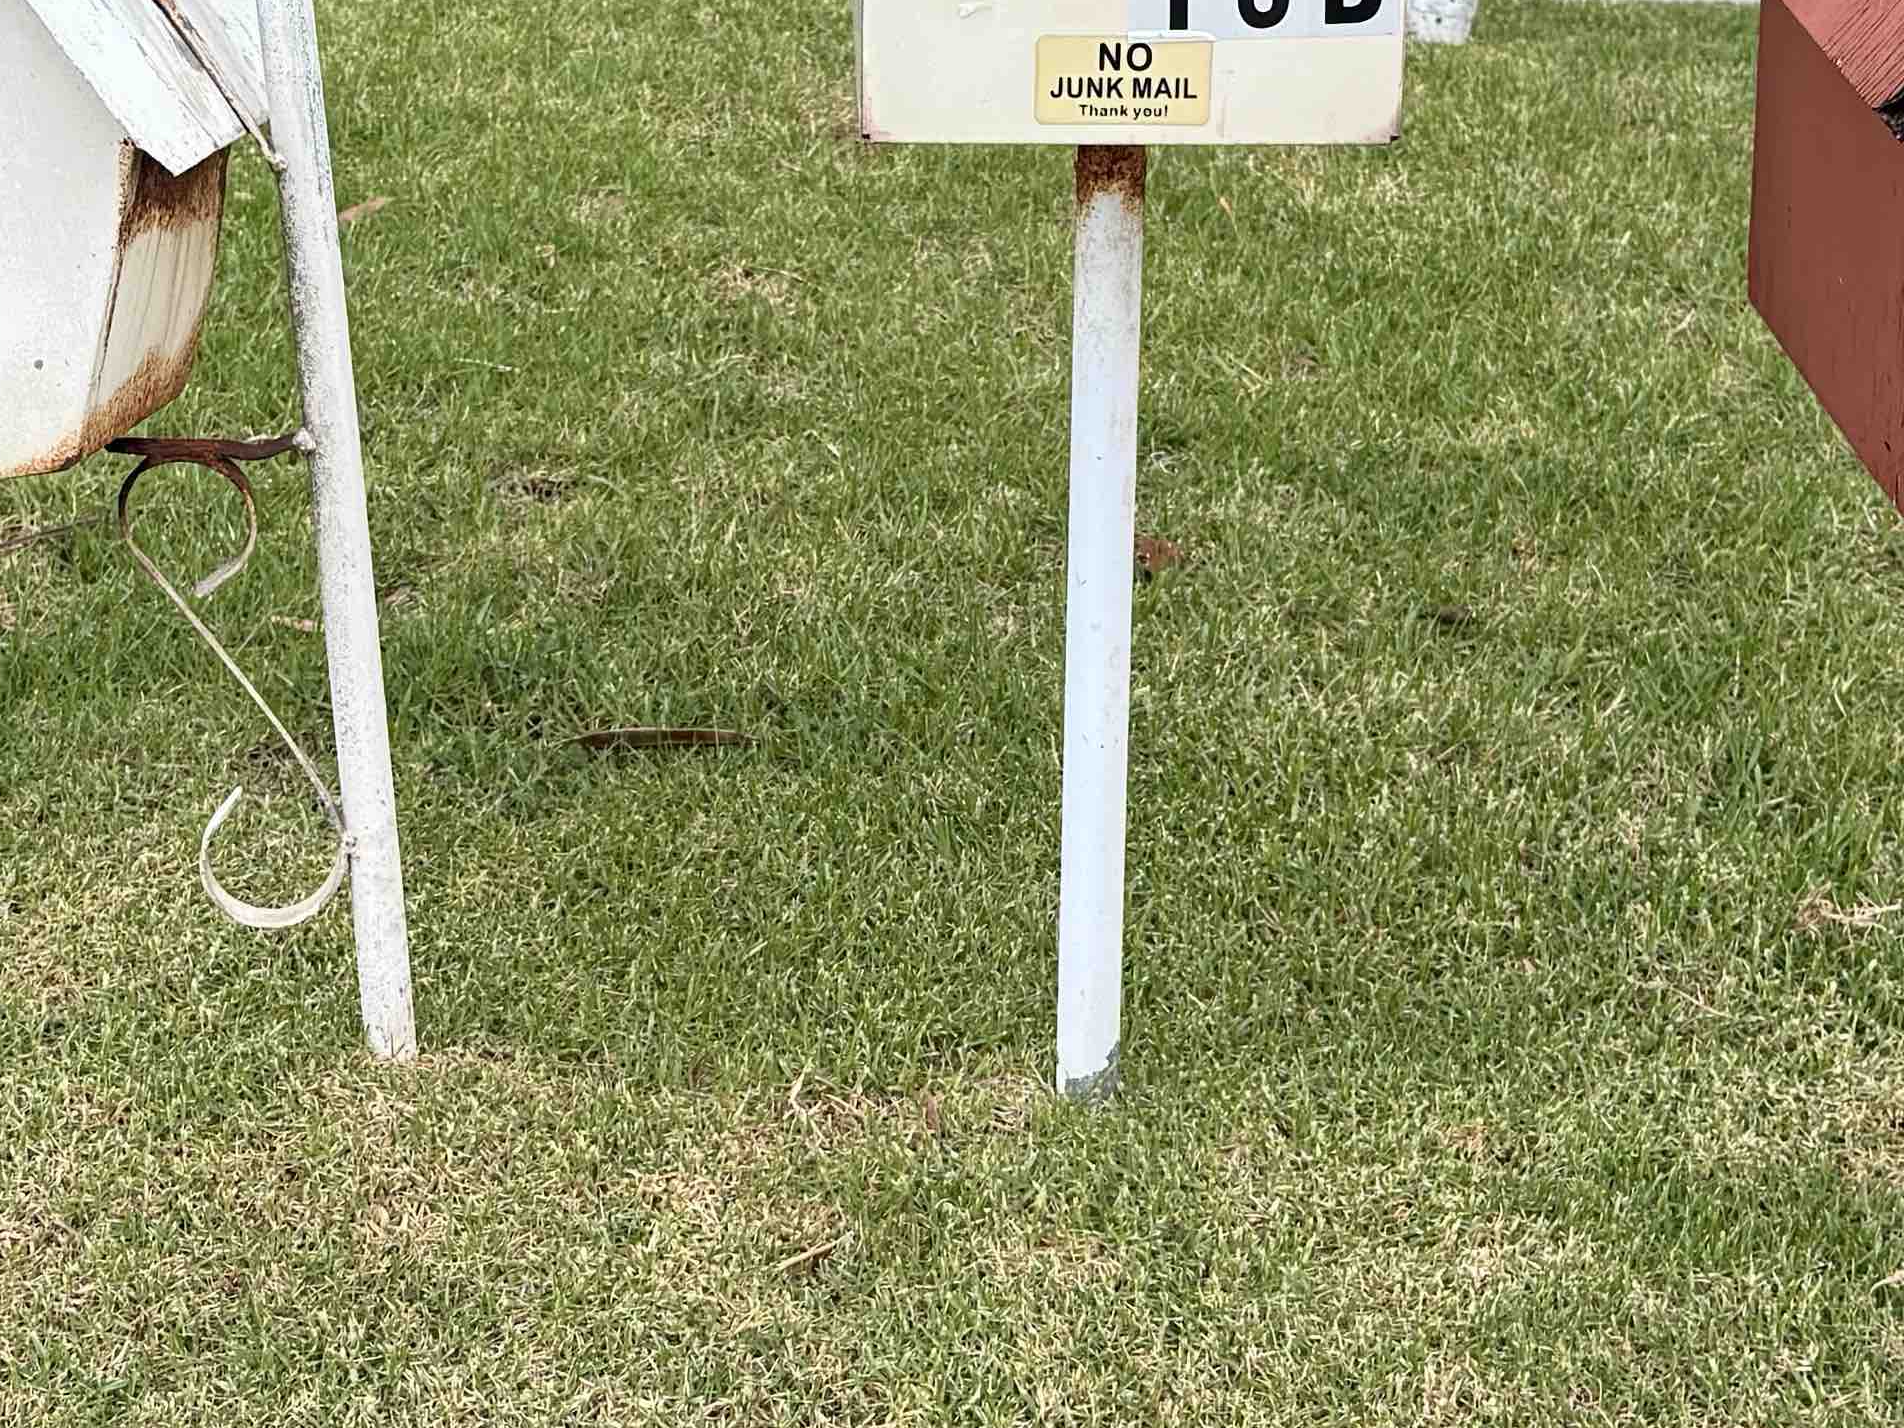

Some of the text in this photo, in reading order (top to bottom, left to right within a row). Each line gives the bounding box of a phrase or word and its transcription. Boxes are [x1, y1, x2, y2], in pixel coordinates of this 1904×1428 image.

[1099, 42, 1153, 71] NO
[1050, 76, 1198, 99] JUNK MAIL
[1079, 104, 1168, 120] Thank you!
